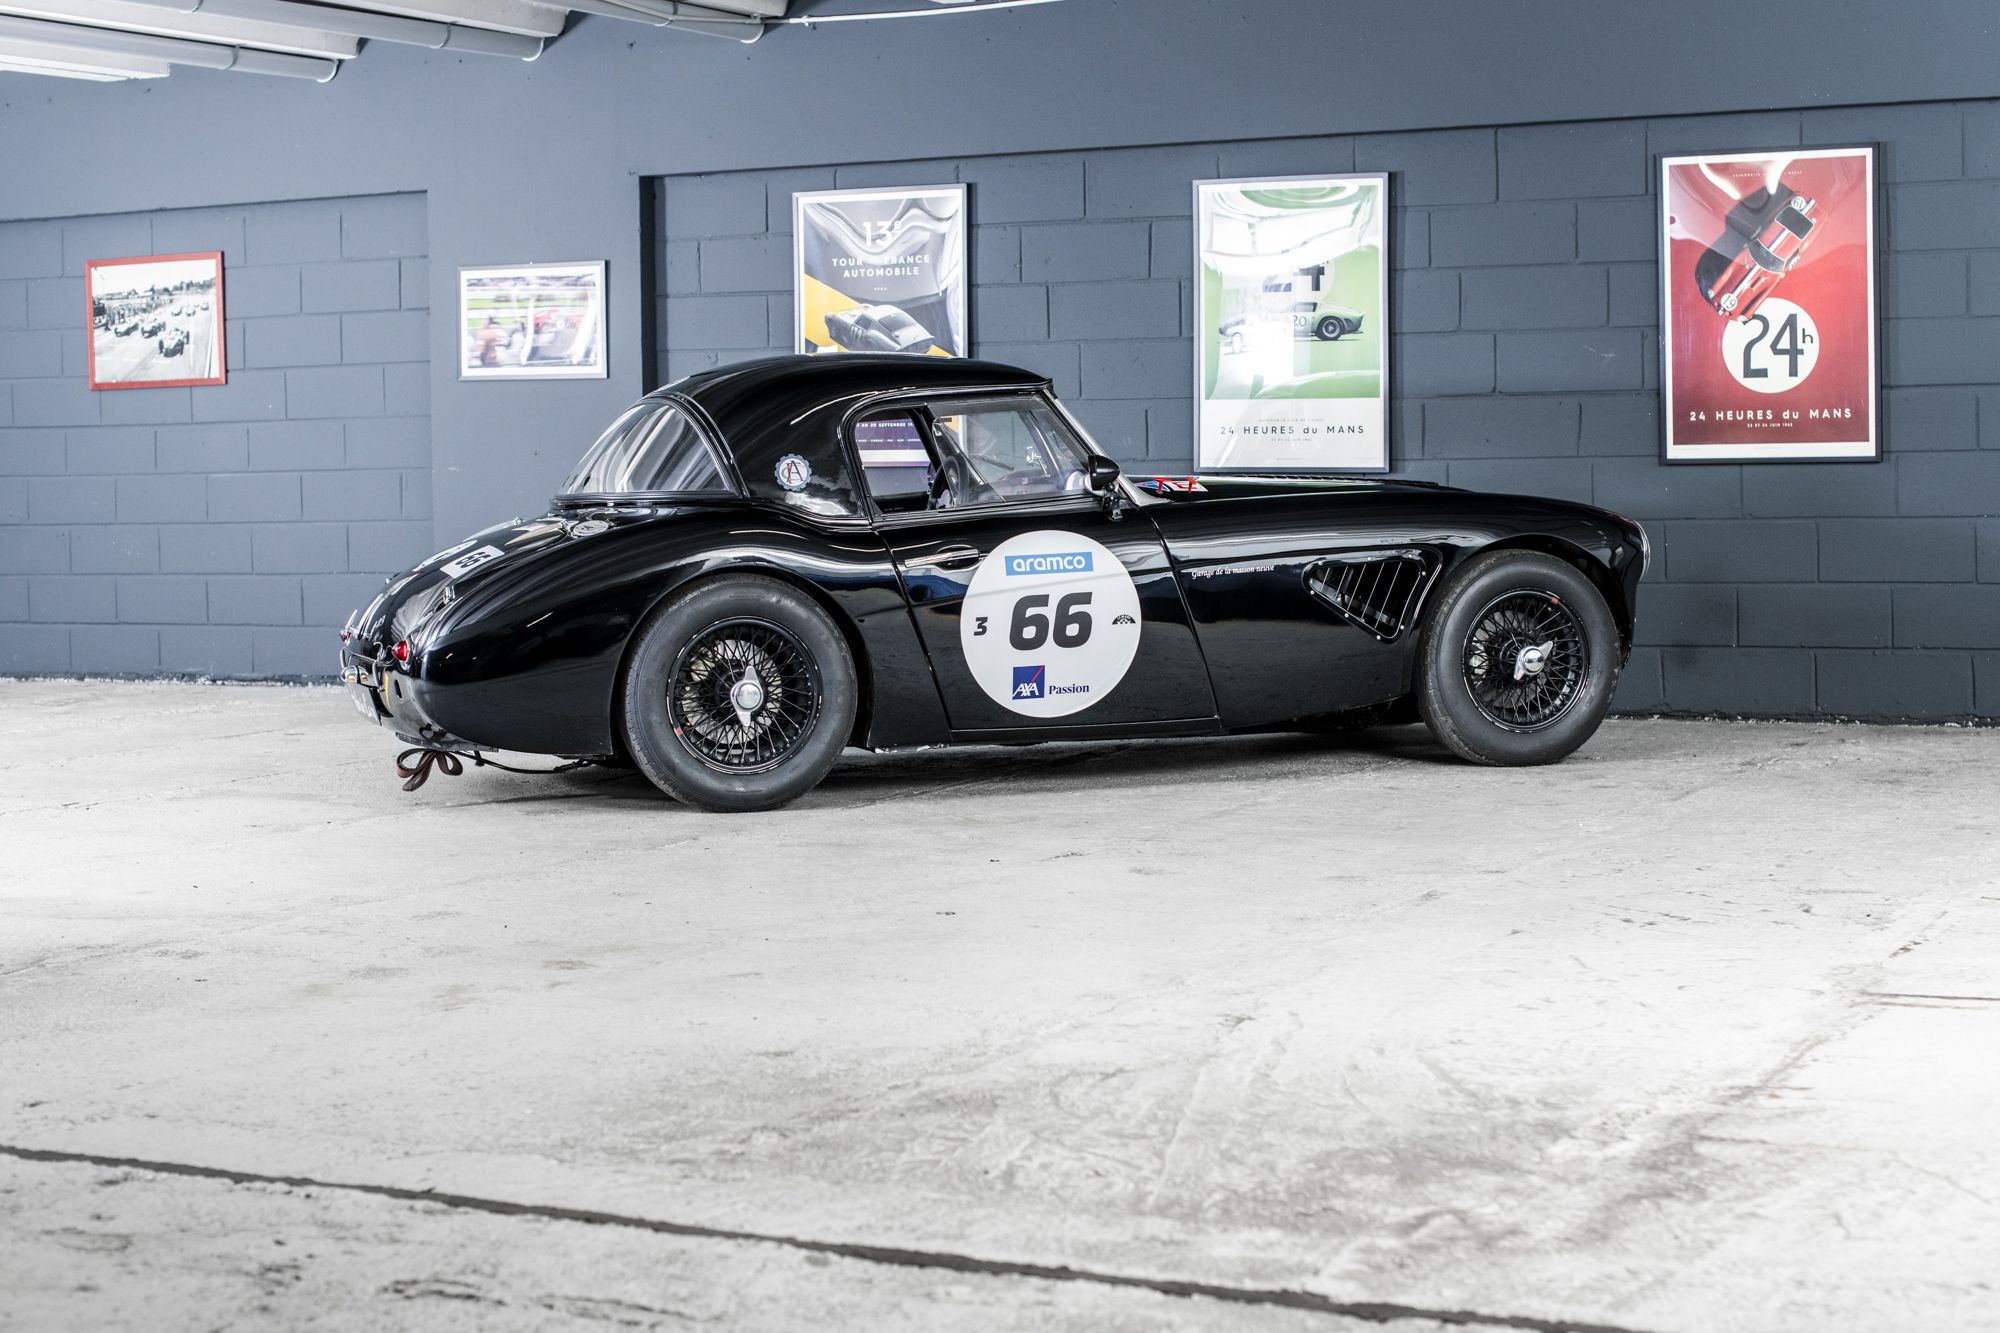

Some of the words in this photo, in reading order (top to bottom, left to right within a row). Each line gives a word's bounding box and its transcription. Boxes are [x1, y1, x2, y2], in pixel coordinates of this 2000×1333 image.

[832, 257, 863, 267] TOUR
[883, 254, 931, 265] FRANCE
[843, 266, 920, 278] AUTOMOBILE
[1689, 411, 1706, 422] 24
[1716, 409, 1773, 421] HEURES
[1782, 409, 1800, 420] du
[1809, 407, 1852, 419] MANS
[1220, 426, 1235, 435] 24
[1243, 425, 1295, 435] HEURES
[1302, 425, 1319, 434] du
[1326, 425, 1365, 434] MANS
[1012, 555, 1086, 572] aramco
[1191, 569, 1214, 580] Garage
[1215, 566, 1224, 576] de
[1224, 566, 1231, 575] la
[973, 616, 988, 636] 3
[1009, 591, 1093, 651] 66
[1012, 682, 1040, 698] AXA
[1048, 683, 1090, 695] Passion
